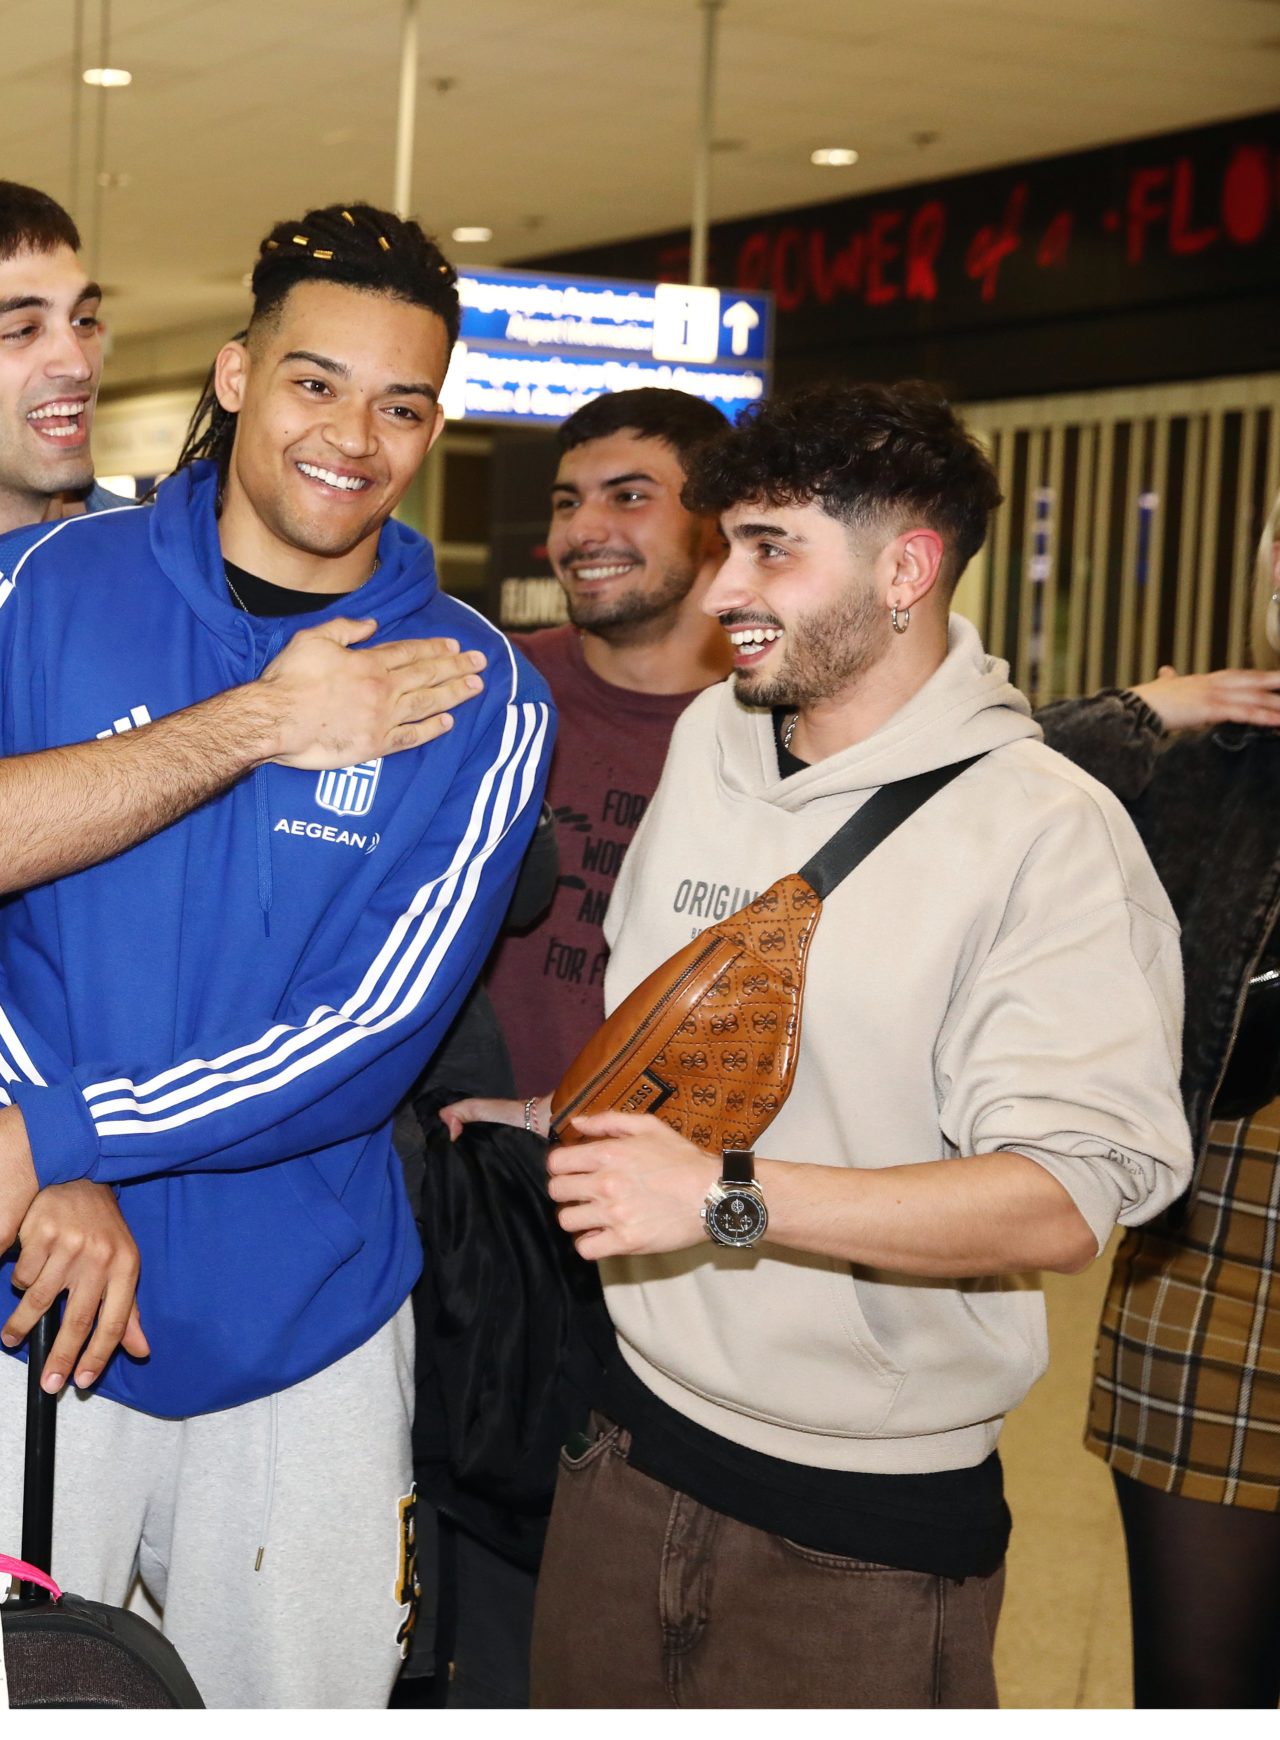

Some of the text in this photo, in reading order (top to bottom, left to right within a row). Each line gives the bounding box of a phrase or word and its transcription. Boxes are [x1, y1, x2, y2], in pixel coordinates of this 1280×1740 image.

[736, 199, 945, 312] POWER
[1127, 144, 1280, 266] FLO
[273, 818, 368, 849] AEGEAN
[543, 937, 586, 985] FOR
